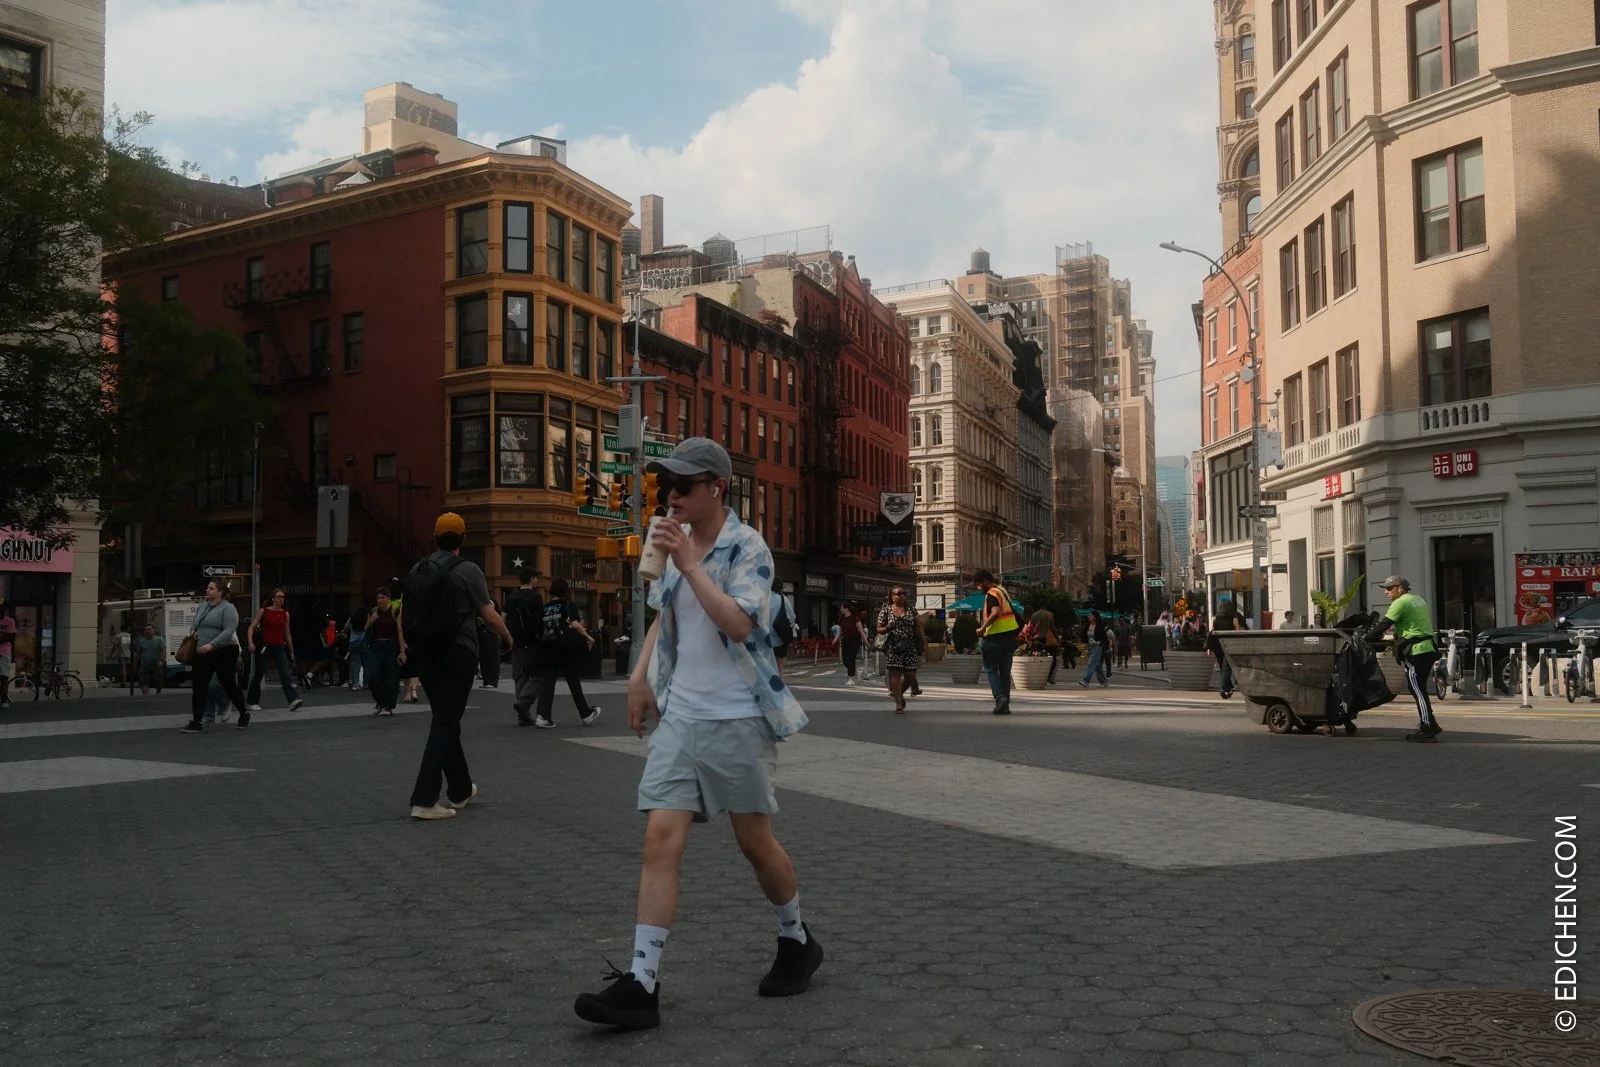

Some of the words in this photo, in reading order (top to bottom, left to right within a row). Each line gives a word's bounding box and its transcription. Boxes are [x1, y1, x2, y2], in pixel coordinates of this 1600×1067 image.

[606, 438, 619, 449] Uni
[643, 444, 655, 454] are
[656, 446, 673, 457] West
[1434, 456, 1449, 466] ユニ
[1456, 454, 1472, 463] UNI
[1456, 462, 1473, 474] QLO
[592, 506, 624, 519] Broadway
[1256, 525, 1263, 533] NO
[1560, 567, 1596, 577] RAFI
